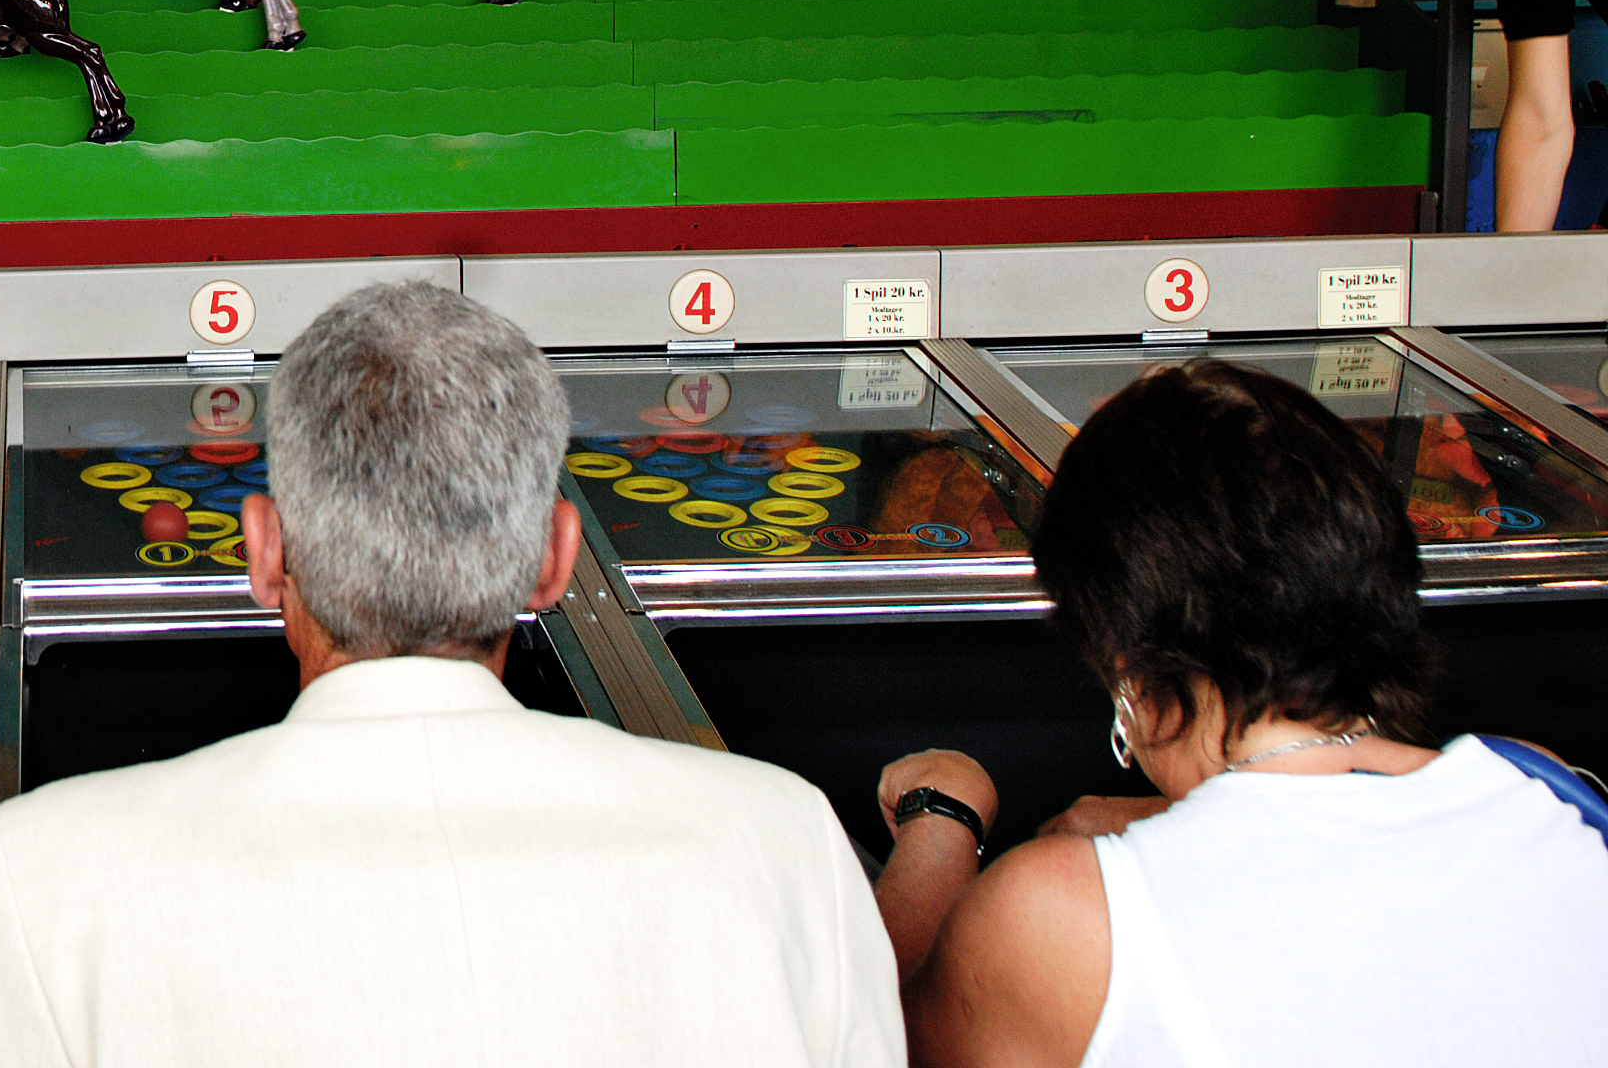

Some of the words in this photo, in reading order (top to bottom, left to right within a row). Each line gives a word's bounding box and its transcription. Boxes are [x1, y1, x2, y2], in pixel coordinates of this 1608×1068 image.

[863, 287, 887, 301] Spil
[890, 287, 905, 298] 20
[909, 286, 925, 297] kr.
[1164, 268, 1194, 312] 3
[1338, 274, 1361, 289] Spil
[1364, 274, 1379, 285] 20
[1382, 273, 1397, 284] kr.
[208, 290, 239, 334] 5
[685, 282, 716, 325] 4
[159, 546, 172, 561] 1
